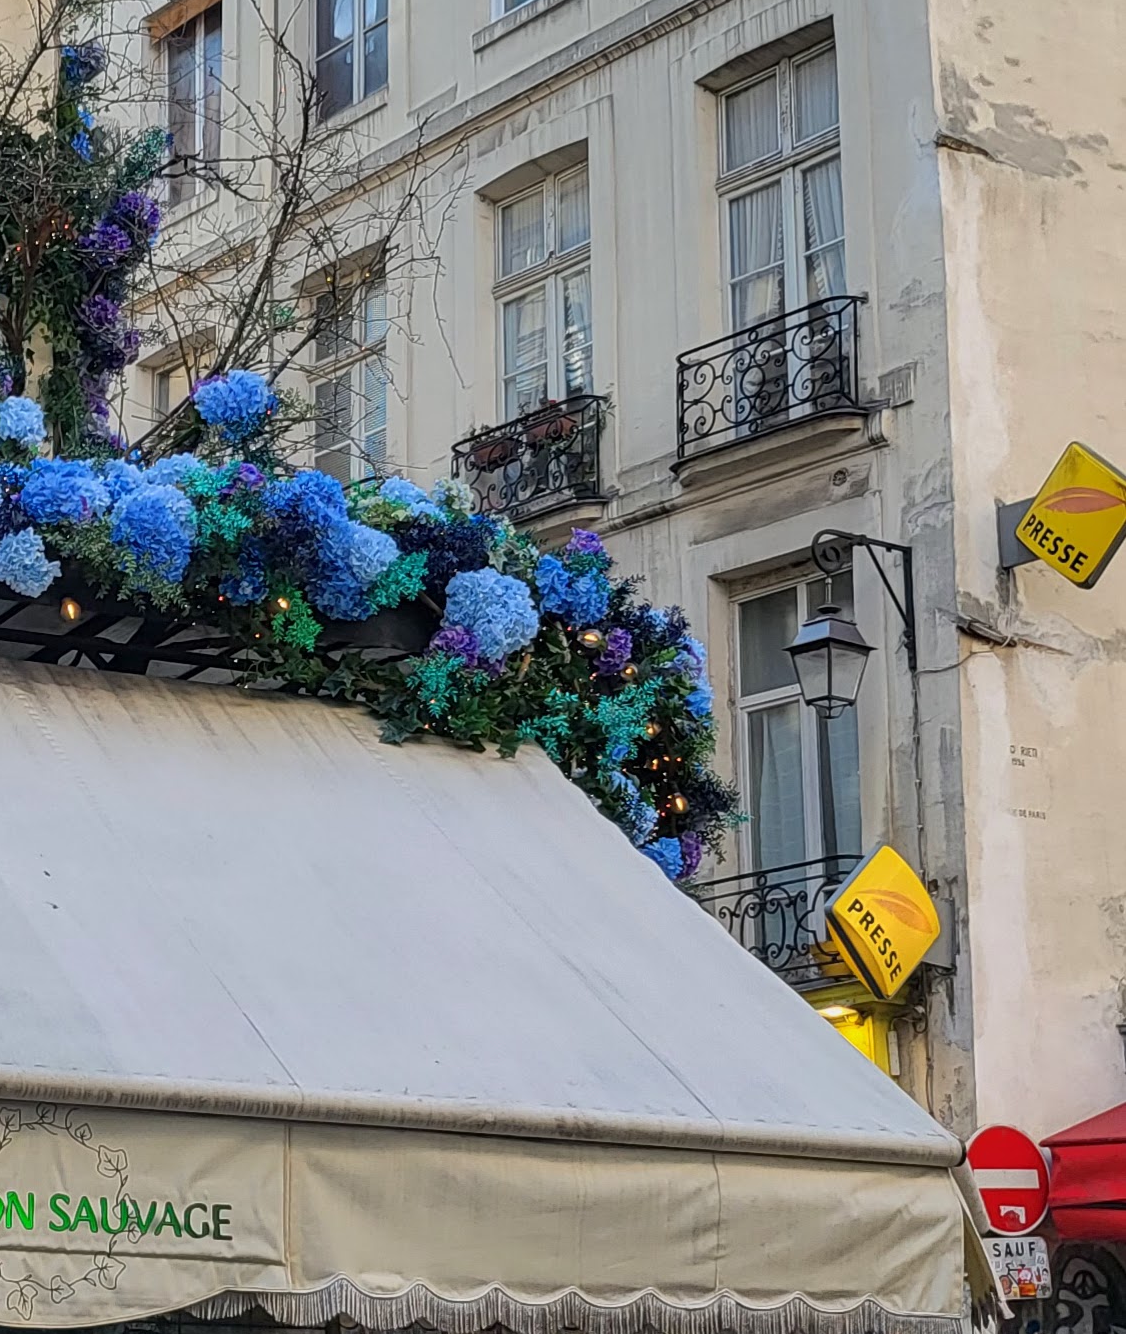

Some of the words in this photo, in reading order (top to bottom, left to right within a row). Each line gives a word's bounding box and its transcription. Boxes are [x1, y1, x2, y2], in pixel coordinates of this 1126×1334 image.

[1022, 513, 1089, 574] PRESSE
[847, 898, 902, 982] PRESSE
[48, 1195, 234, 1241] SAUVAGE
[992, 1241, 1036, 1258] SAUF
